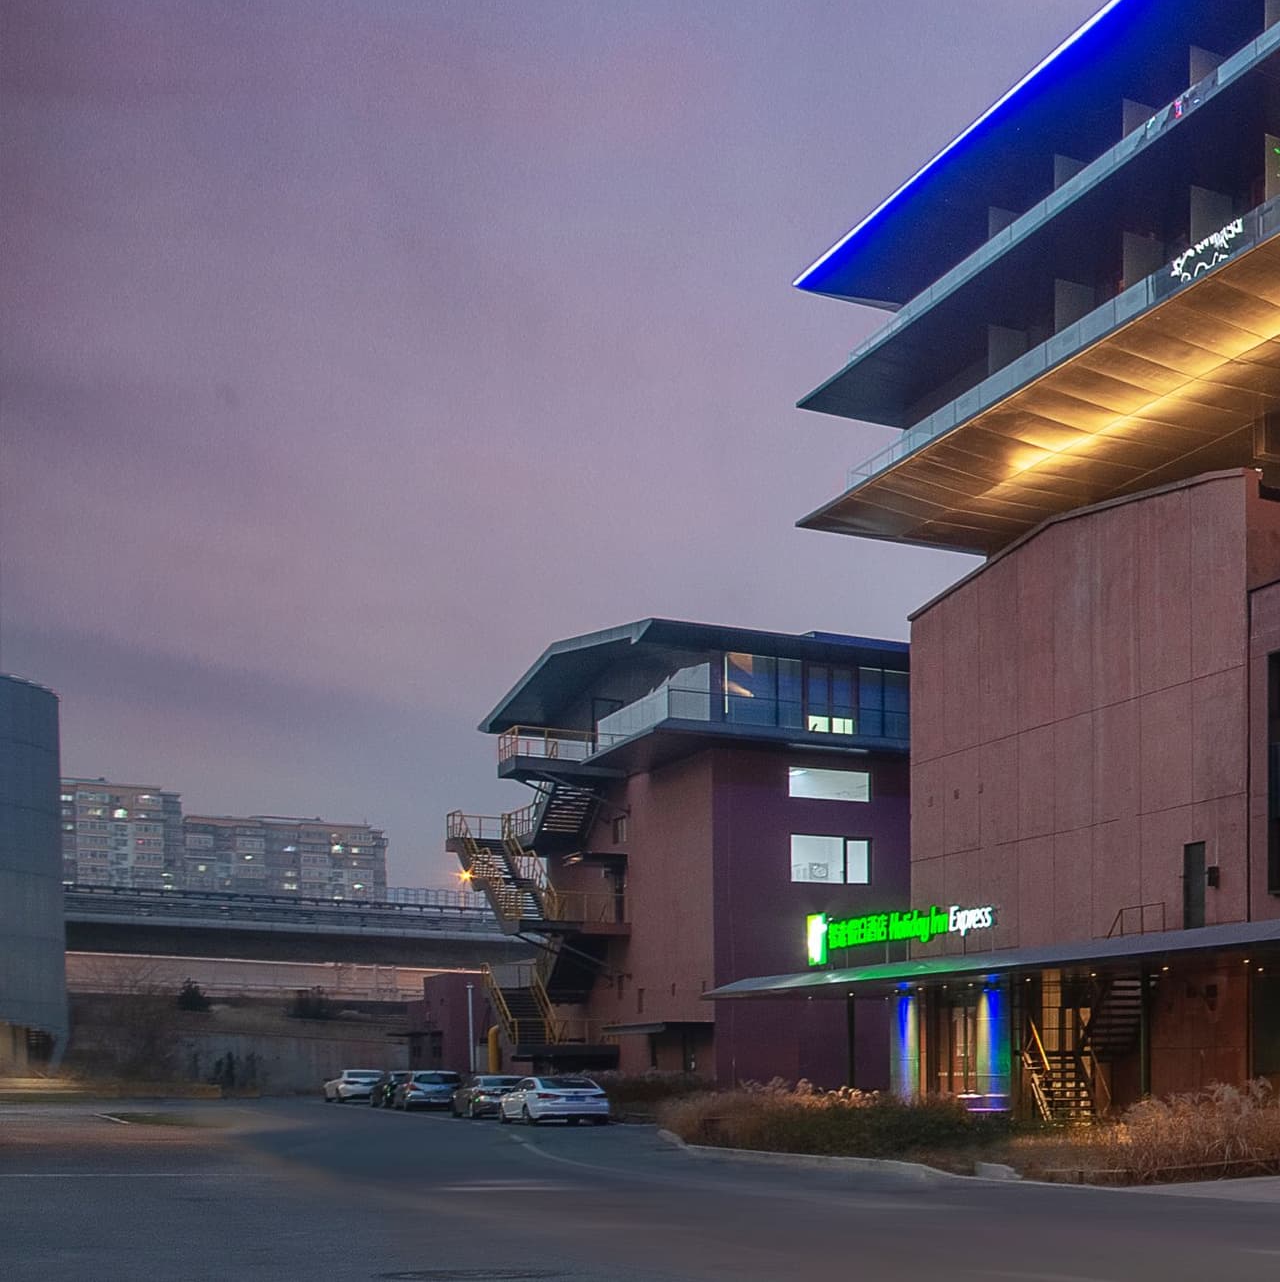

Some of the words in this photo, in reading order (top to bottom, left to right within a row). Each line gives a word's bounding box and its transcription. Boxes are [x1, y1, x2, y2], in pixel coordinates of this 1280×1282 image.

[889, 910, 931, 942] Holiday
[931, 906, 948, 933] Inn
[949, 906, 992, 936] Express
